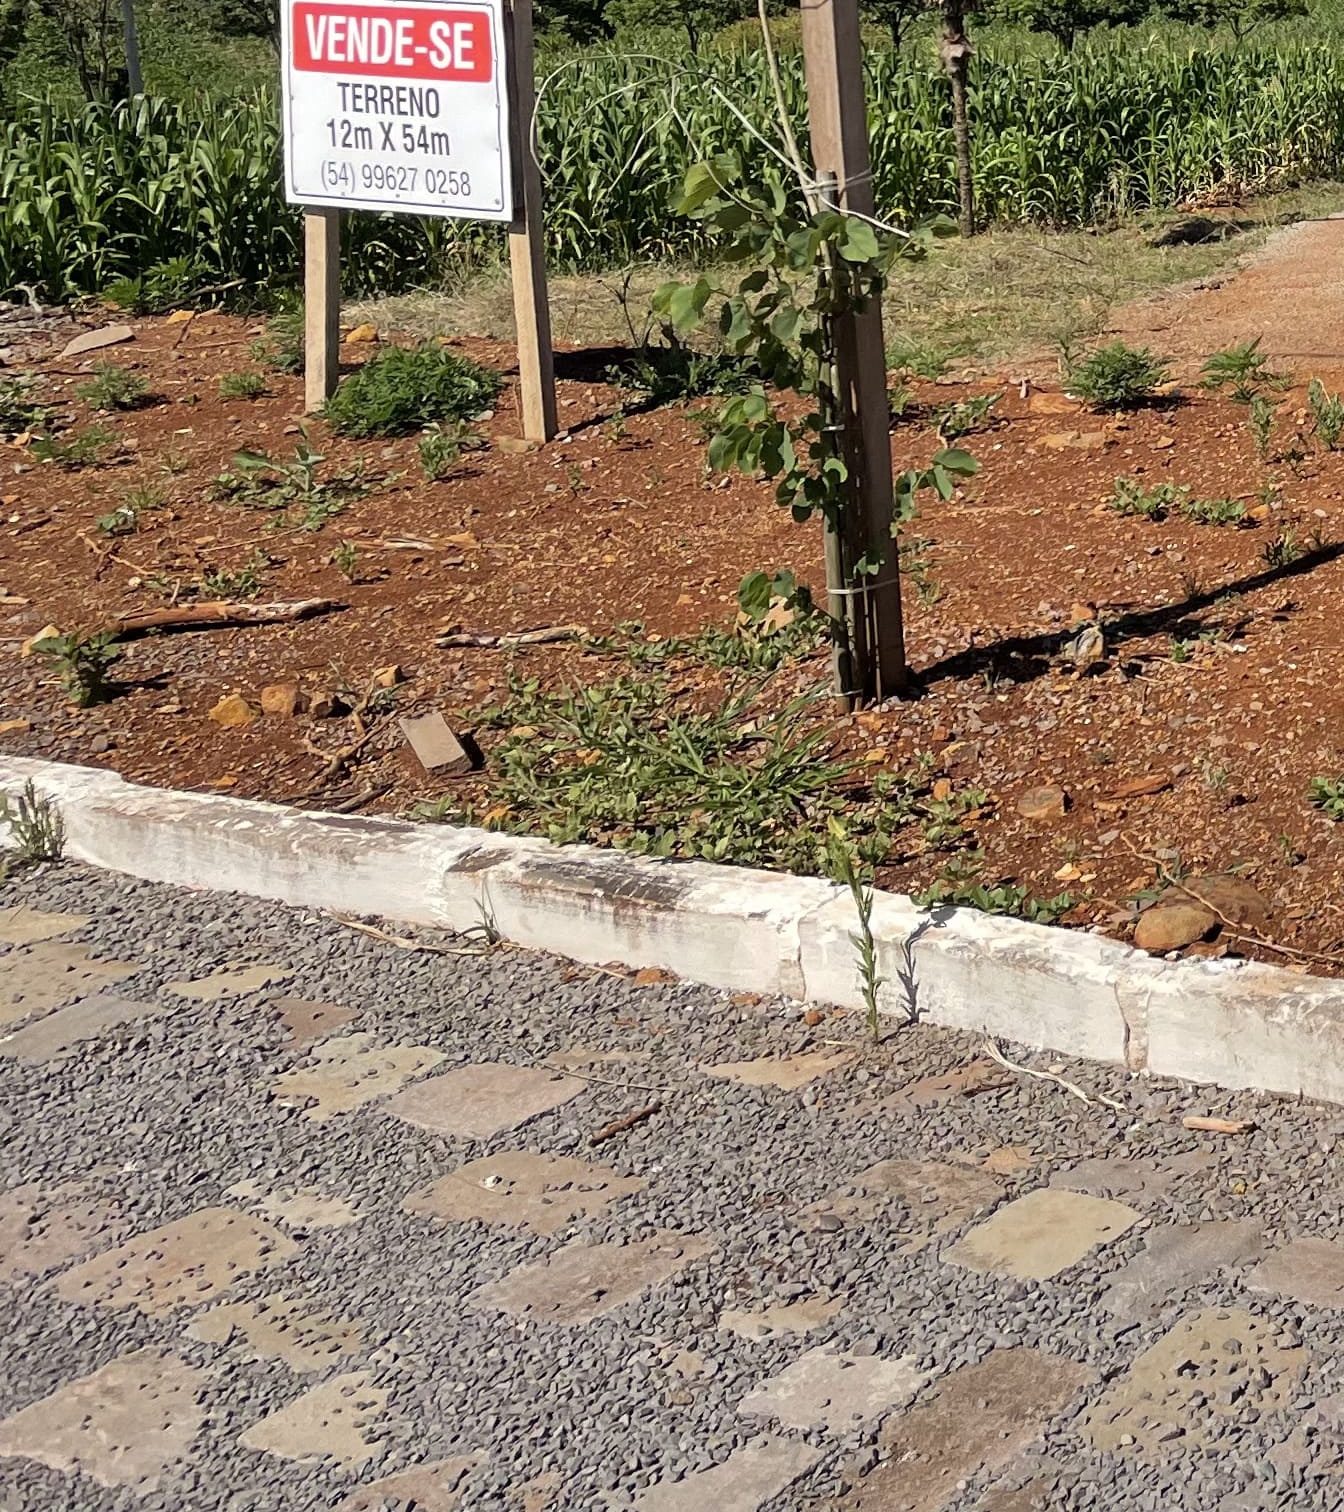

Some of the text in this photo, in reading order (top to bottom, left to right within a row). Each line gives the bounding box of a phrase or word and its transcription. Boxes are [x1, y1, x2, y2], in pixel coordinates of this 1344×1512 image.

[304, 13, 475, 70] VENDE-SE
[336, 81, 440, 119] TERRENO
[326, 118, 450, 156] 12m X 54m
[321, 159, 472, 196] (54) 99627 0258
